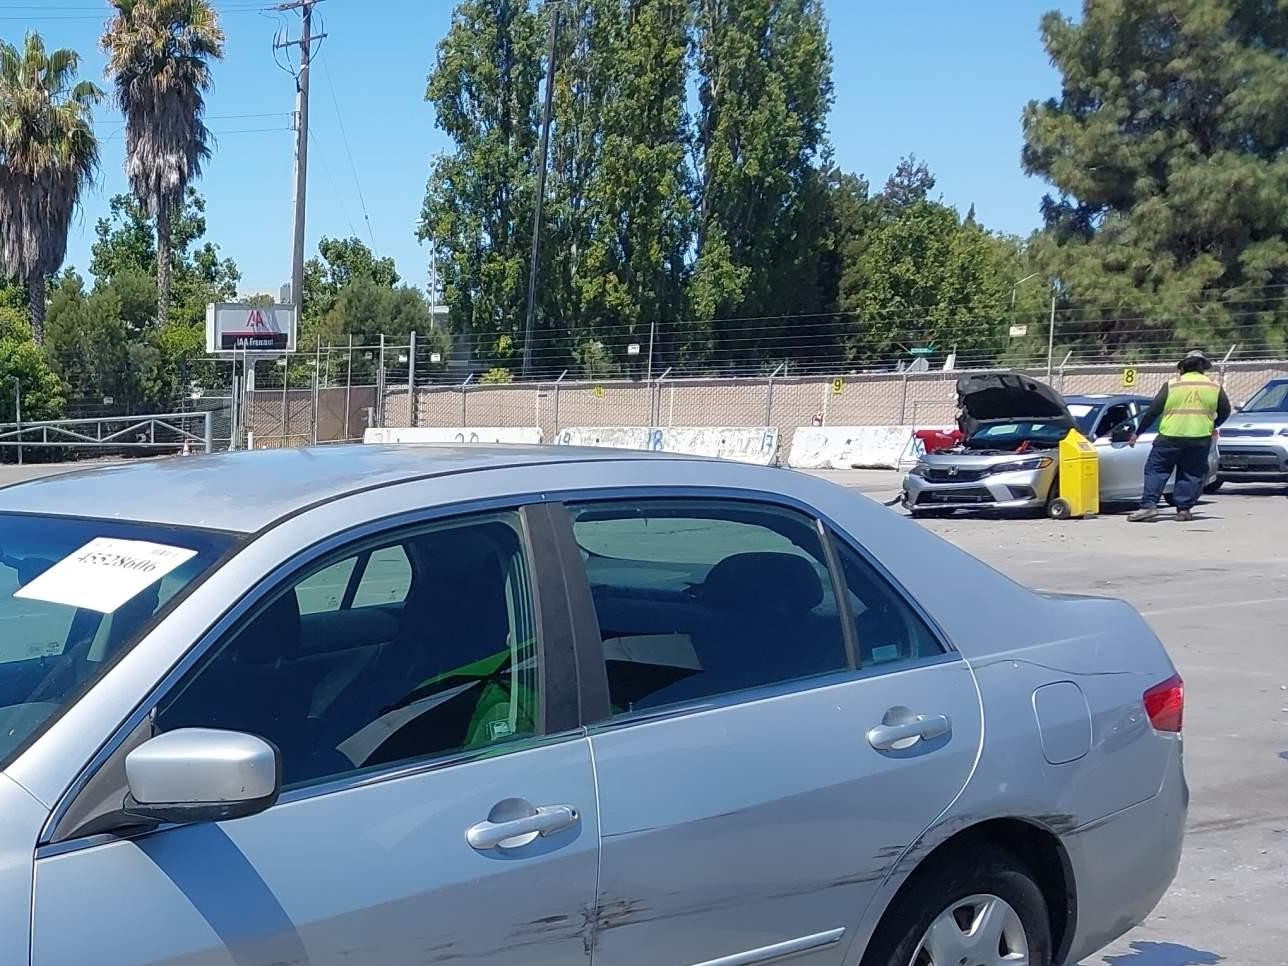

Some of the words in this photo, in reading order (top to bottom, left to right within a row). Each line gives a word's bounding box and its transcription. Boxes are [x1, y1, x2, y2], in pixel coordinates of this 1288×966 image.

[1125, 369, 1134, 383] 8
[834, 379, 841, 391] 9
[77, 552, 157, 573] 45528606
